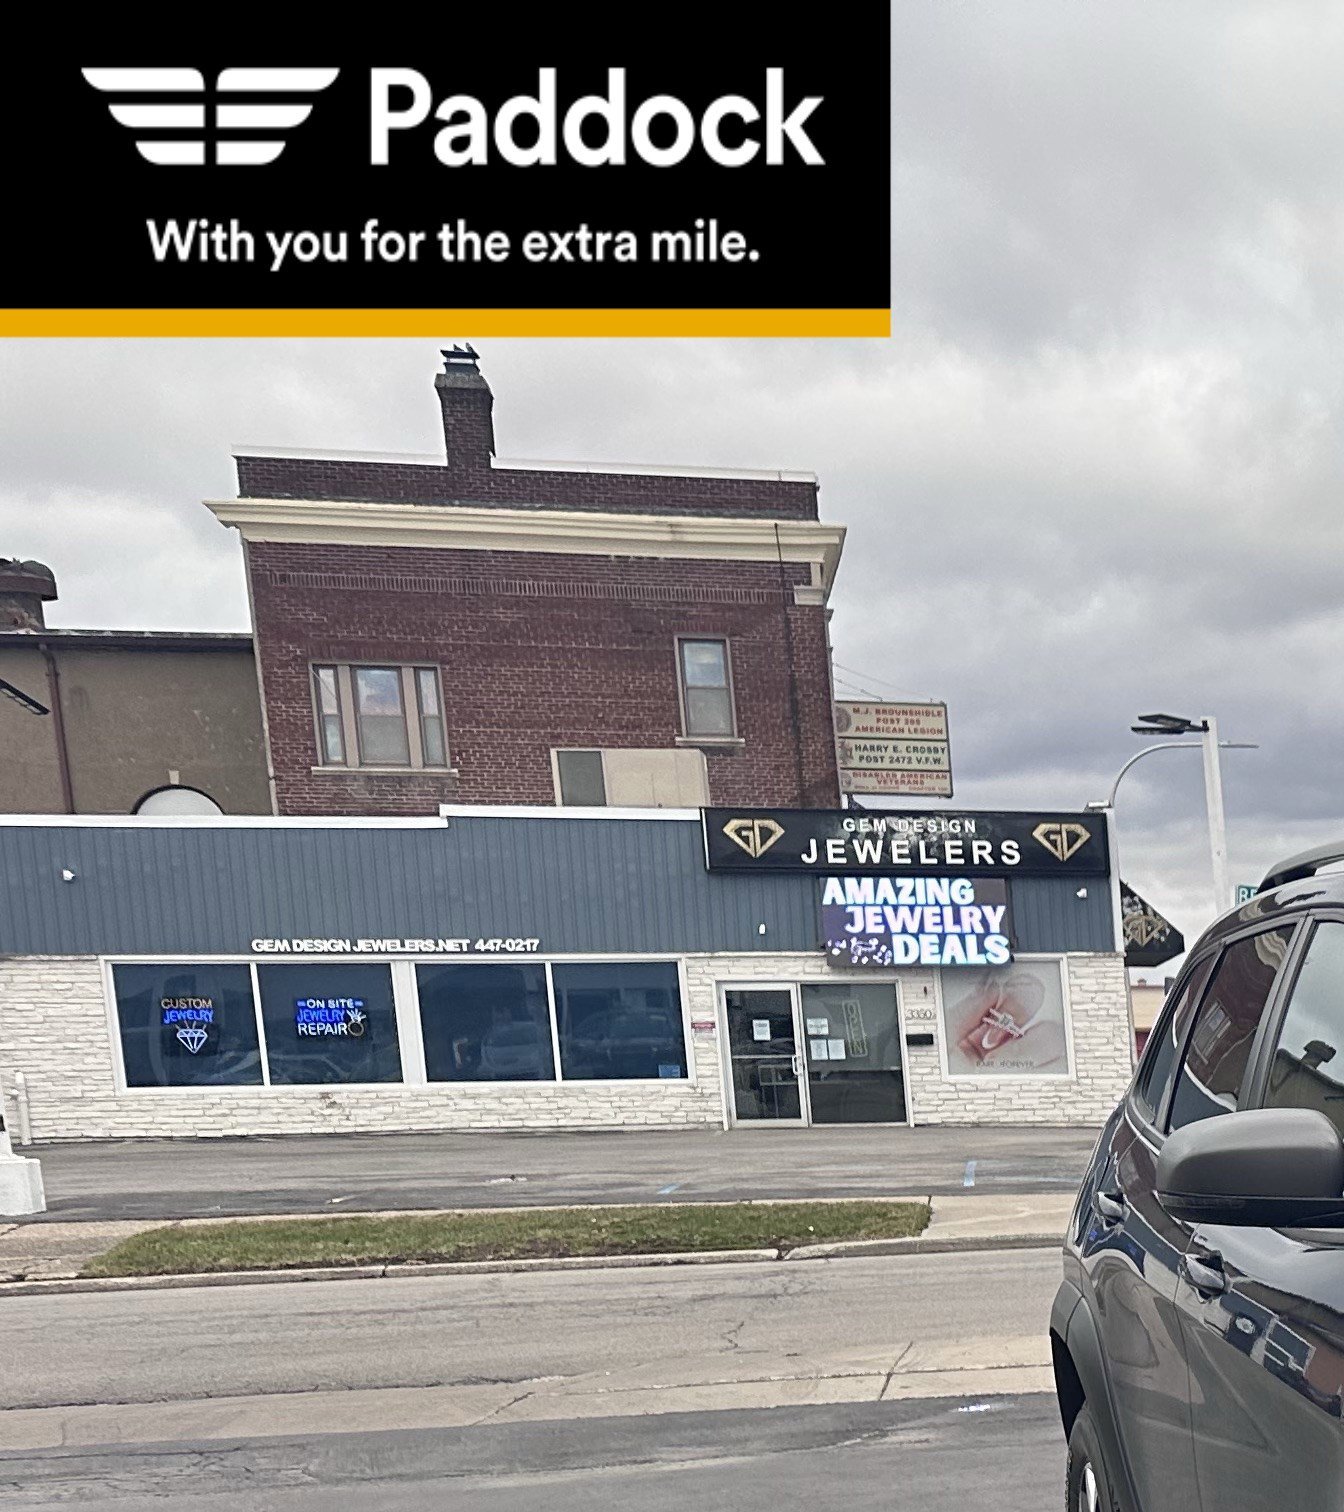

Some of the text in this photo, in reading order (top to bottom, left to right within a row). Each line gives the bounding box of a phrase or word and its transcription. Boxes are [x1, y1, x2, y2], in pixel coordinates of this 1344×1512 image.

[876, 717, 900, 725] POST
[855, 725, 944, 735] AMERICAN LEGION
[854, 743, 889, 753] HARRY
[905, 745, 947, 755] CROSBY
[858, 755, 886, 763] POST
[888, 756, 913, 764] 2472
[842, 817, 977, 835] GEM DESIGN
[801, 838, 1022, 867] JEWELERS
[822, 877, 975, 906] AMAZING
[844, 905, 1006, 935] JEWELRY
[251, 938, 540, 952] GEM DESIGN JEWELERS.NET 447-0217
[893, 934, 1011, 965] DEALS
[161, 998, 213, 1009] CUSTOM
[306, 999, 354, 1009] ON SITE
[163, 1009, 214, 1024] JEWELRY
[297, 1009, 345, 1023] JEWELRY
[298, 1022, 348, 1036] REPAIR
